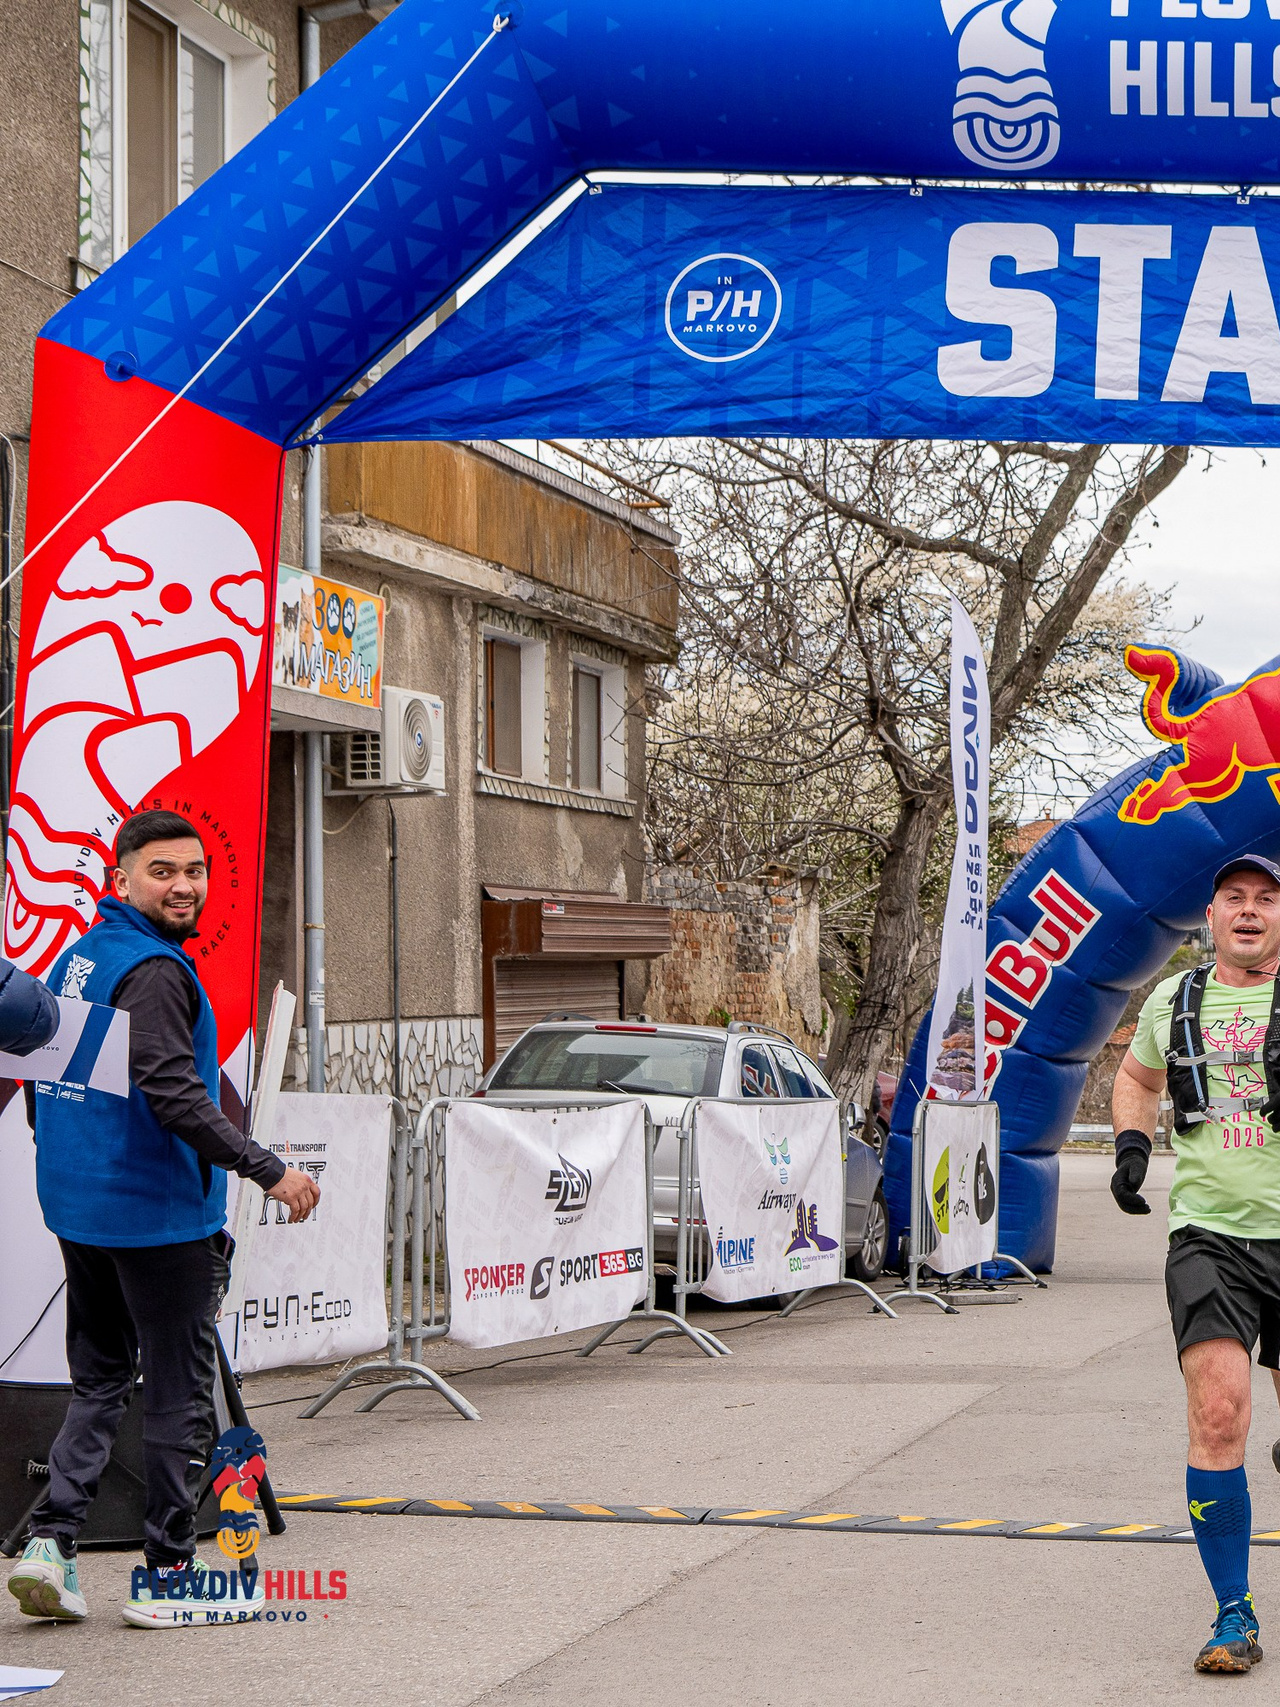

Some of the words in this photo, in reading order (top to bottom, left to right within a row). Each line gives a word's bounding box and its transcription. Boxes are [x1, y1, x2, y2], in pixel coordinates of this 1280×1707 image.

[717, 276, 733, 285] IN
[686, 290, 762, 321] P/H
[683, 324, 757, 333] MARKOVO
[300, 641, 373, 698] МАГАЗИН
[106, 799, 163, 826] HILLS
[174, 800, 192, 813] IN
[200, 811, 239, 888] MARKOVO
[74, 827, 102, 906] PLOVDIV
[200, 920, 231, 958] RACE
[985, 869, 1102, 1009] Bull
[290, 1143, 327, 1152] TRANSPORT
[1222, 1126, 1265, 1149] 2025
[789, 1257, 803, 1273] ECO
